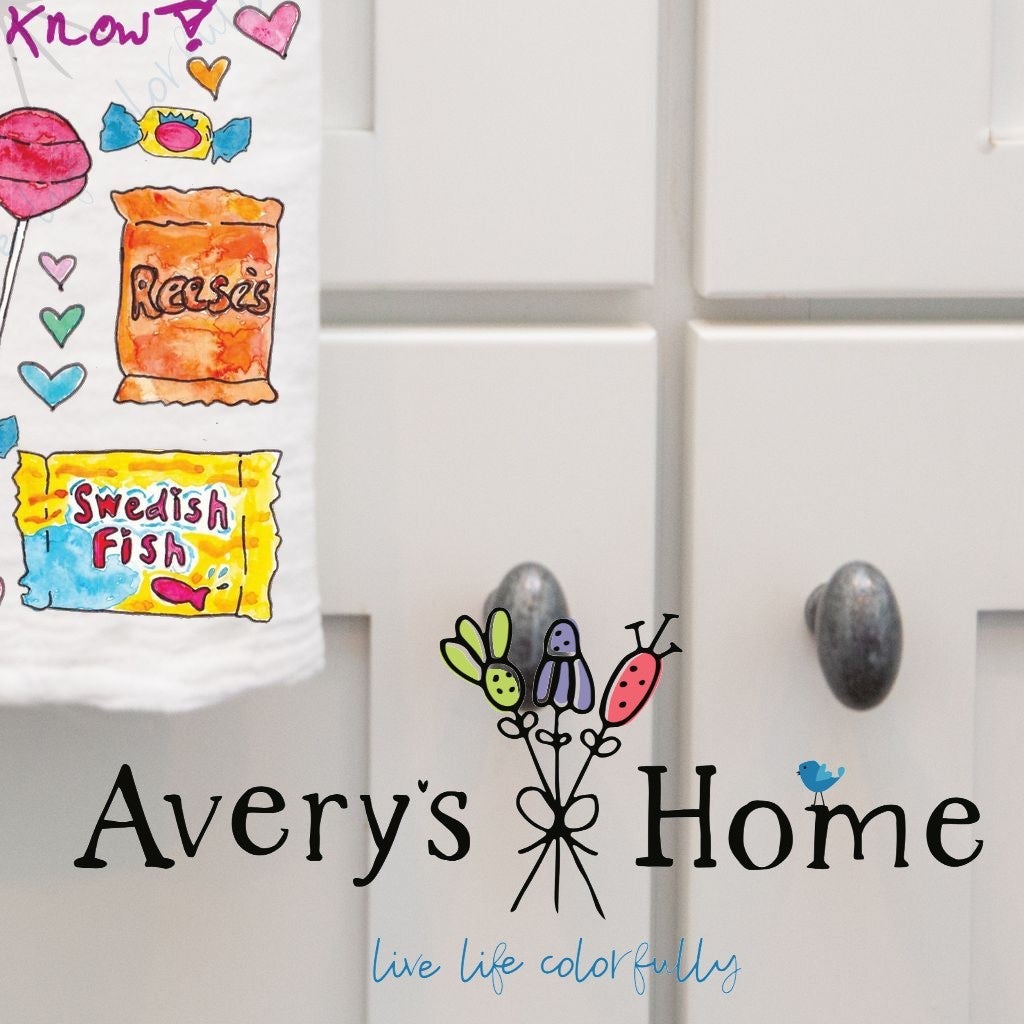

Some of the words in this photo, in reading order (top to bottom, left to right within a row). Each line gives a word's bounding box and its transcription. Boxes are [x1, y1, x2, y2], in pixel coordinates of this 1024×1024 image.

[130, 264, 271, 321] Reese's
[74, 483, 228, 530] Swedish
[93, 527, 186, 569] Fish
